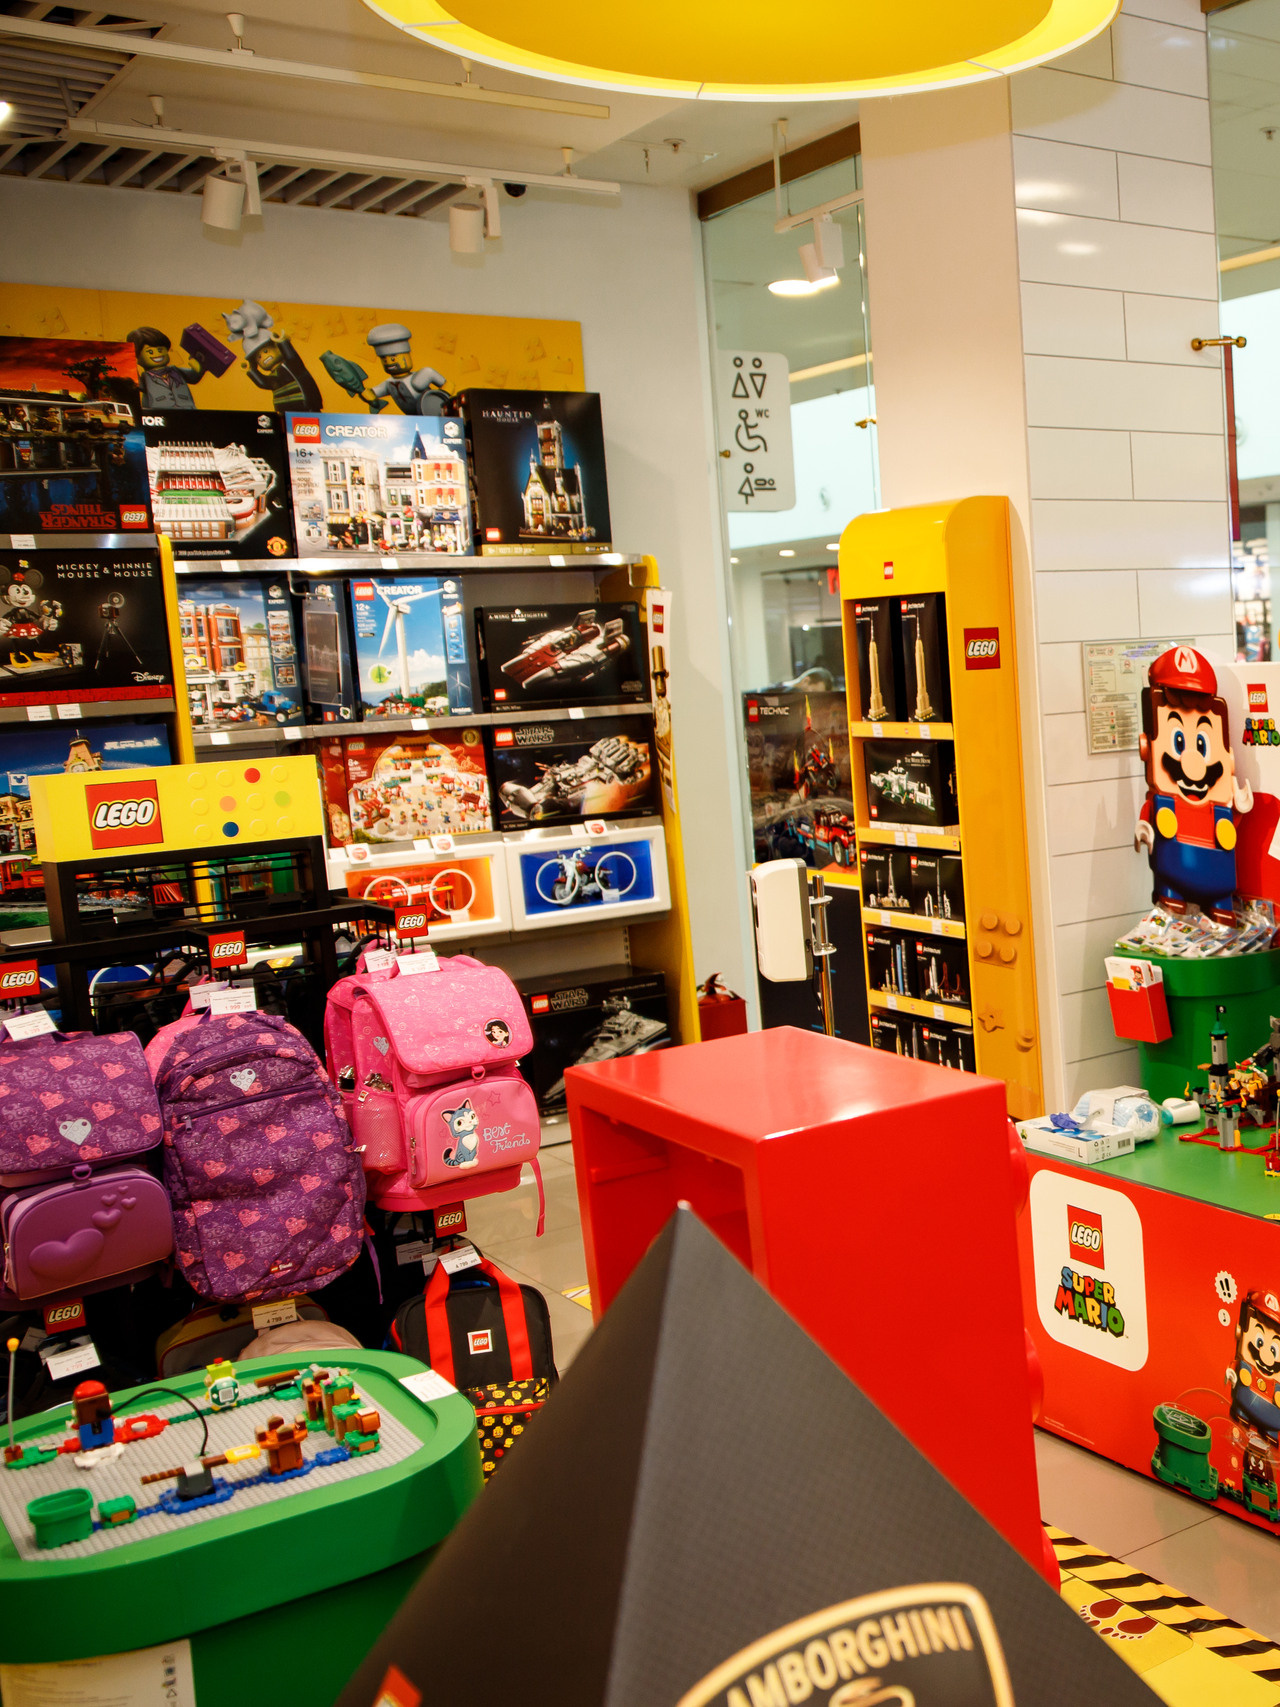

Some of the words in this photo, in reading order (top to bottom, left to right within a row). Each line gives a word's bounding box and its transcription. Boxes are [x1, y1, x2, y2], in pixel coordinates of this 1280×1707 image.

[482, 410, 532, 418] HAUNTED
[755, 408, 770, 418] WC
[294, 424, 319, 437] LEGO
[325, 424, 388, 438] CREATOR
[295, 448, 314, 457] 16+
[50, 504, 104, 515] THINGS
[122, 511, 147, 522] LEGO
[40, 512, 118, 530] STRANGER
[56, 563, 99, 571] MICKEY
[103, 566, 110, 574] &
[966, 640, 998, 657] LEGO
[1249, 691, 1266, 704] LEGO
[759, 707, 790, 716] TECHNIC
[516, 726, 554, 736] STAR
[1245, 717, 1275, 731] SUPER
[515, 733, 554, 746] WARS
[1242, 729, 1280, 747] MARIO
[94, 799, 155, 829] LEGO
[399, 915, 425, 929] LEGO
[213, 942, 243, 958] LEGO
[2, 971, 36, 988] LEGO
[551, 997, 588, 1010] WARS
[482, 1122, 511, 1141] Best
[490, 1132, 531, 1154] Friends
[437, 1211, 462, 1228] LEGO
[1070, 1221, 1101, 1251] LEGO
[1061, 1265, 1116, 1308] SUPER
[48, 1303, 81, 1323] LEGO
[1054, 1284, 1125, 1338] MARIO
[473, 1337, 488, 1346] LEGO
[724, 1605, 974, 1707] AMBORGHINI
